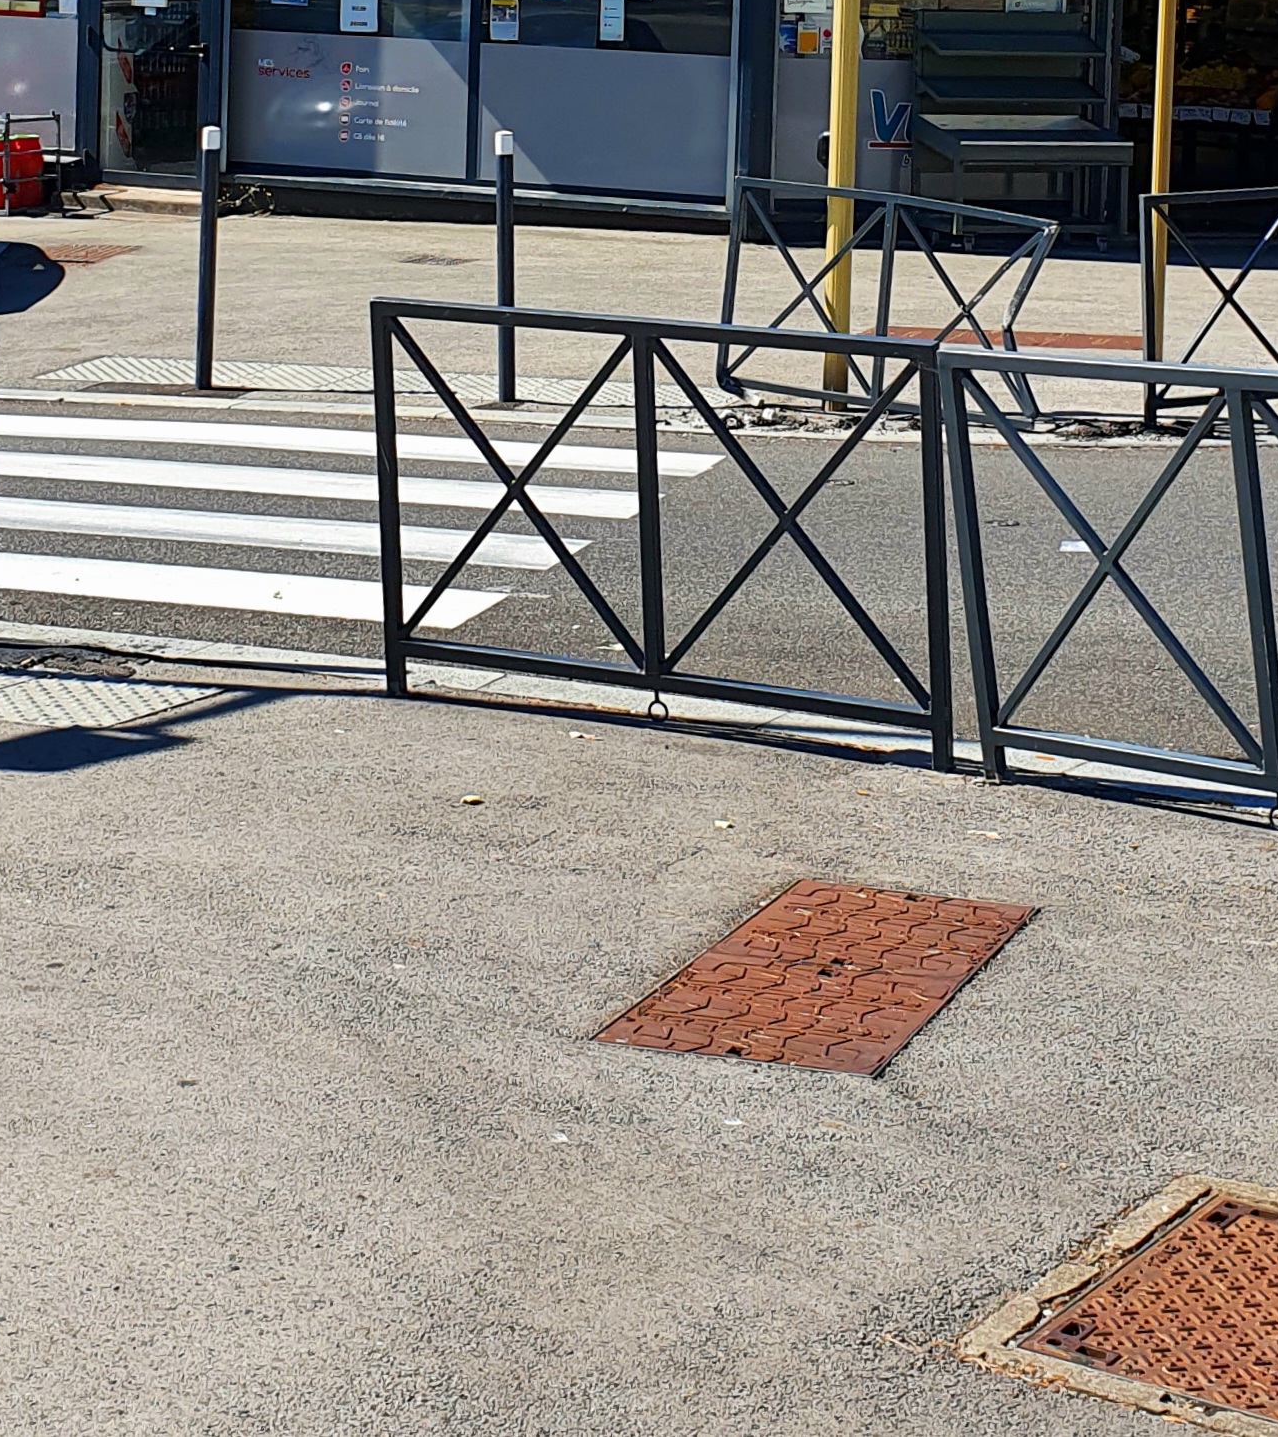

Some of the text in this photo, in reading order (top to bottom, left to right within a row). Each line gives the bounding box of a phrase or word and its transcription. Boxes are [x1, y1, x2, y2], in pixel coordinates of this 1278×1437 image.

[258, 66, 311, 79] services
[354, 116, 373, 125] Carte
[374, 118, 383, 126] de
